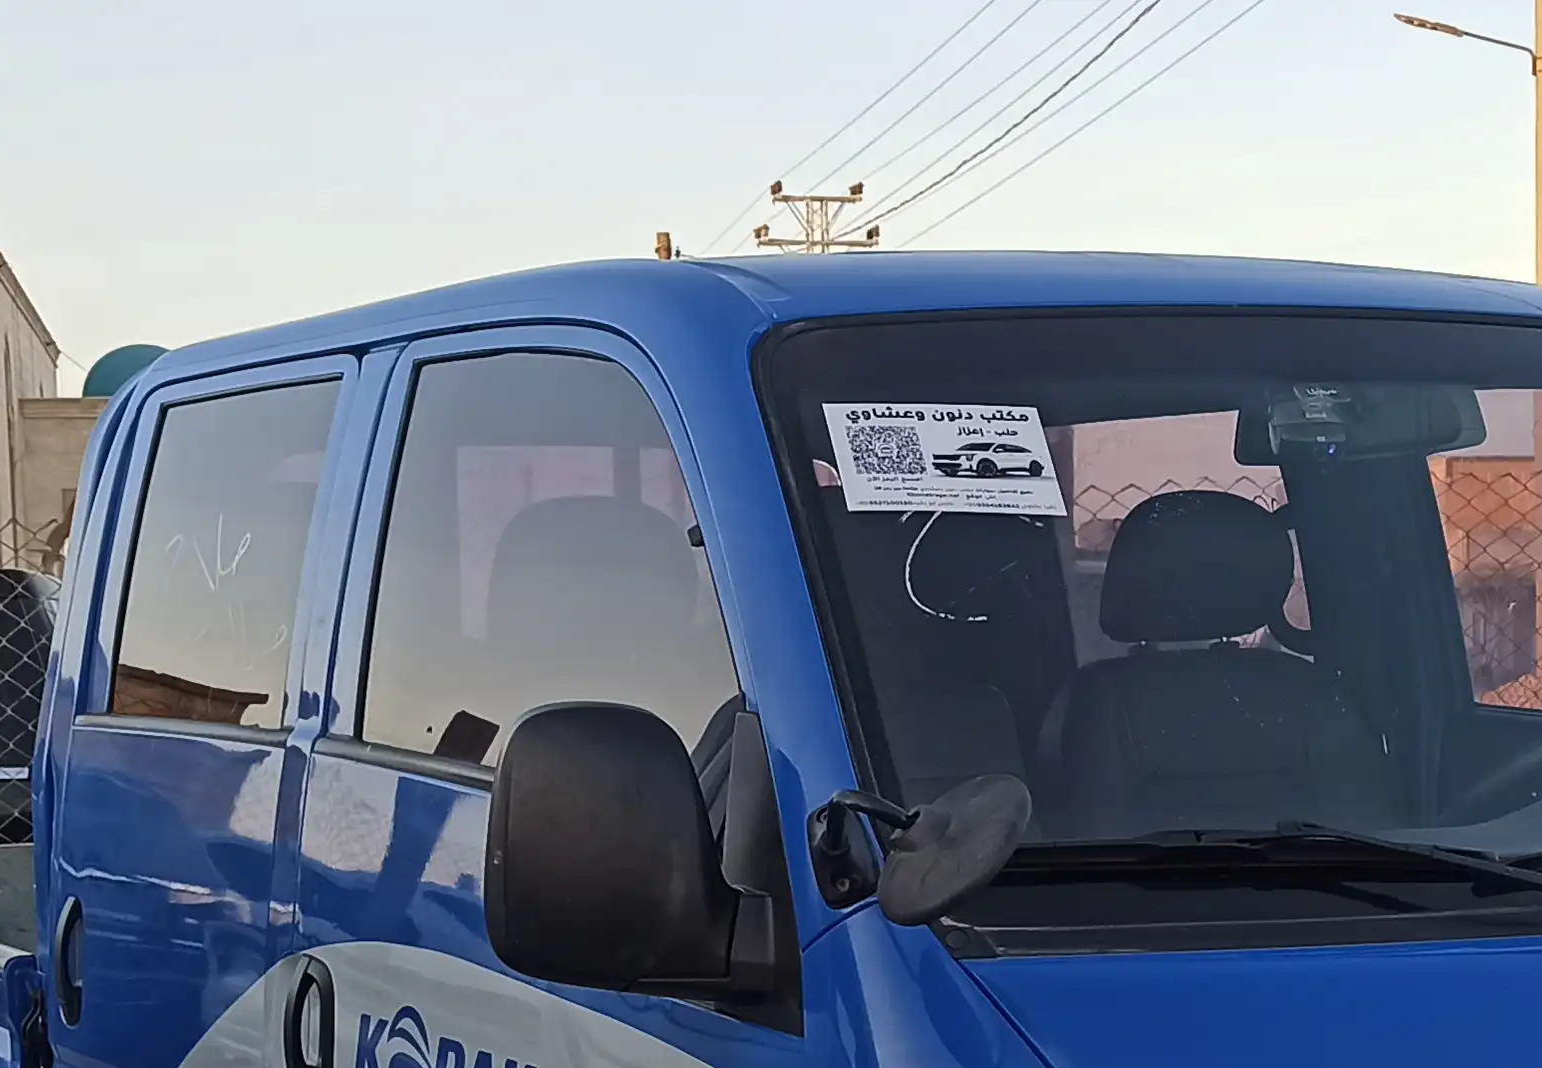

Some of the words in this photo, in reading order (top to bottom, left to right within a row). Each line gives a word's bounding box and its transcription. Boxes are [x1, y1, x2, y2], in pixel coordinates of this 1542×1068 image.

[845, 406, 925, 424] وعشاوي
[932, 409, 973, 422] دنون
[980, 410, 1029, 423] مكتب
[994, 427, 1018, 436] حلب
